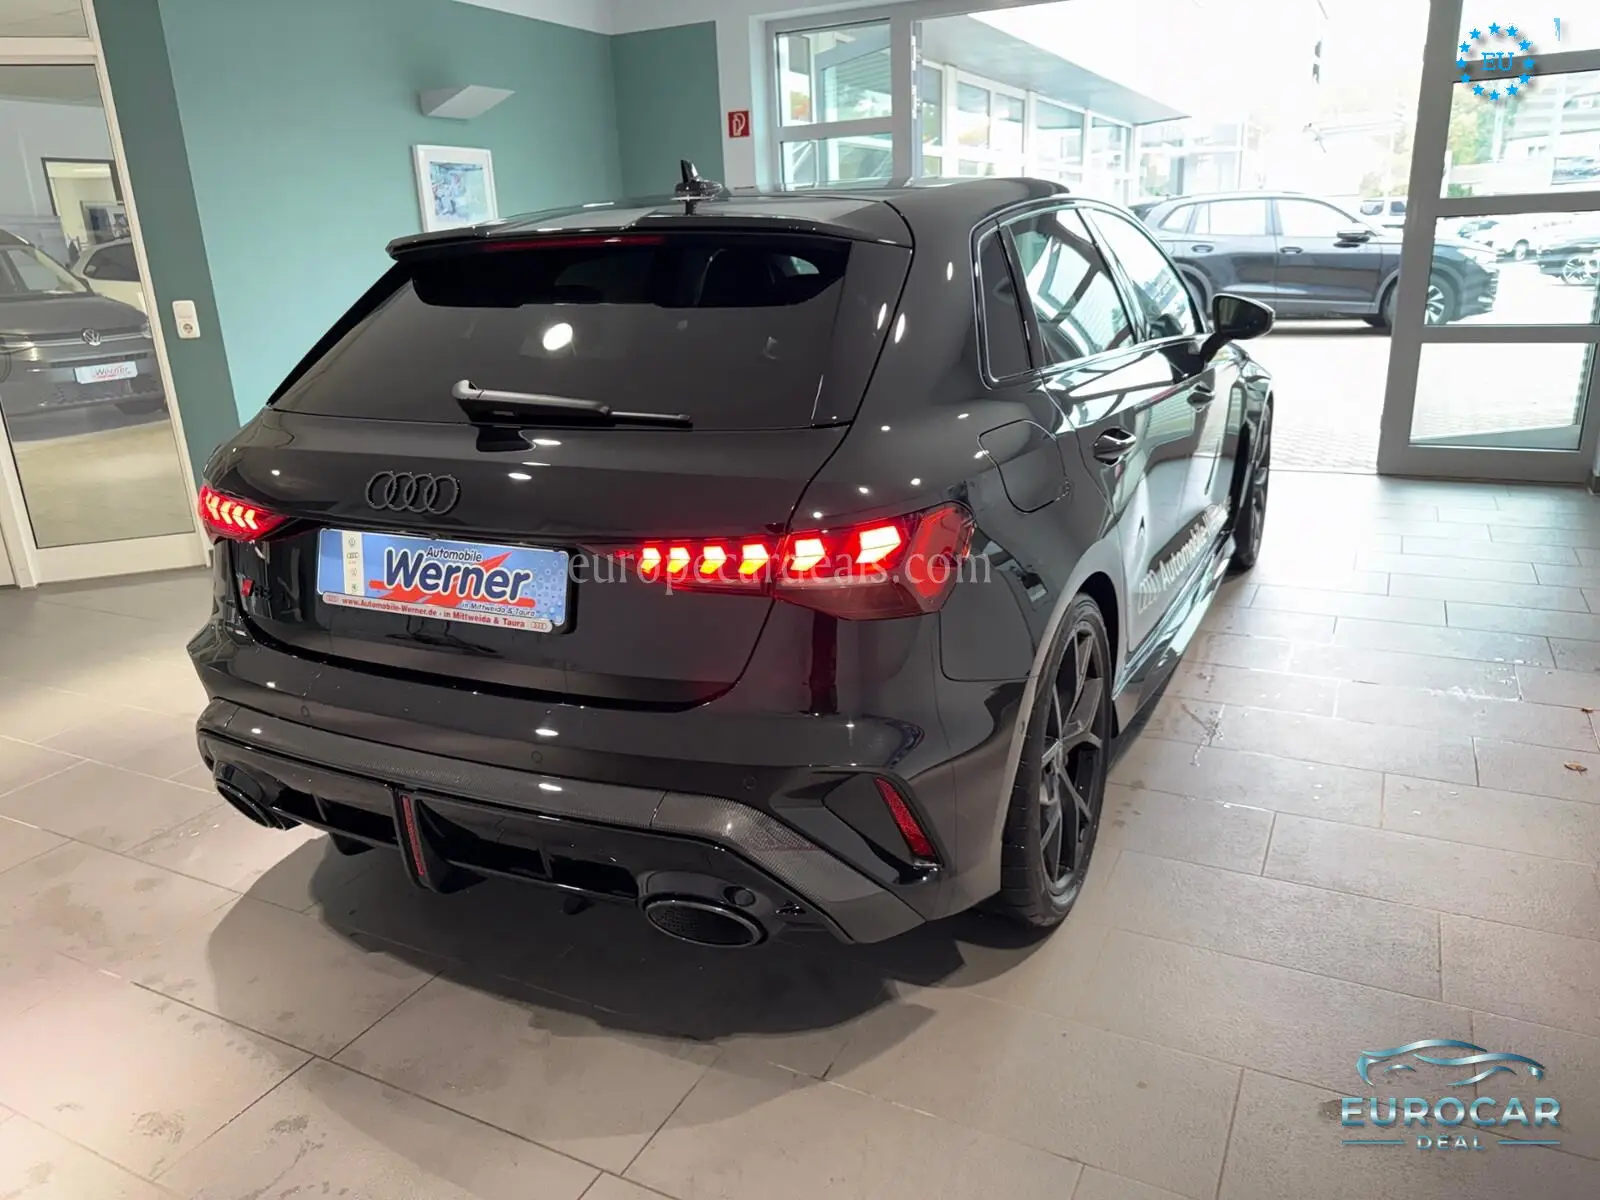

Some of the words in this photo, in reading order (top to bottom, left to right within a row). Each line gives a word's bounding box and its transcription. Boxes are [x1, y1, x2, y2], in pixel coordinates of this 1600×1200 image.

[426, 546, 482, 563] Automobile
[386, 548, 532, 601] Werner
[453, 611, 491, 623] Mittweida
[493, 616, 499, 624] &
[502, 618, 526, 628] Taura
